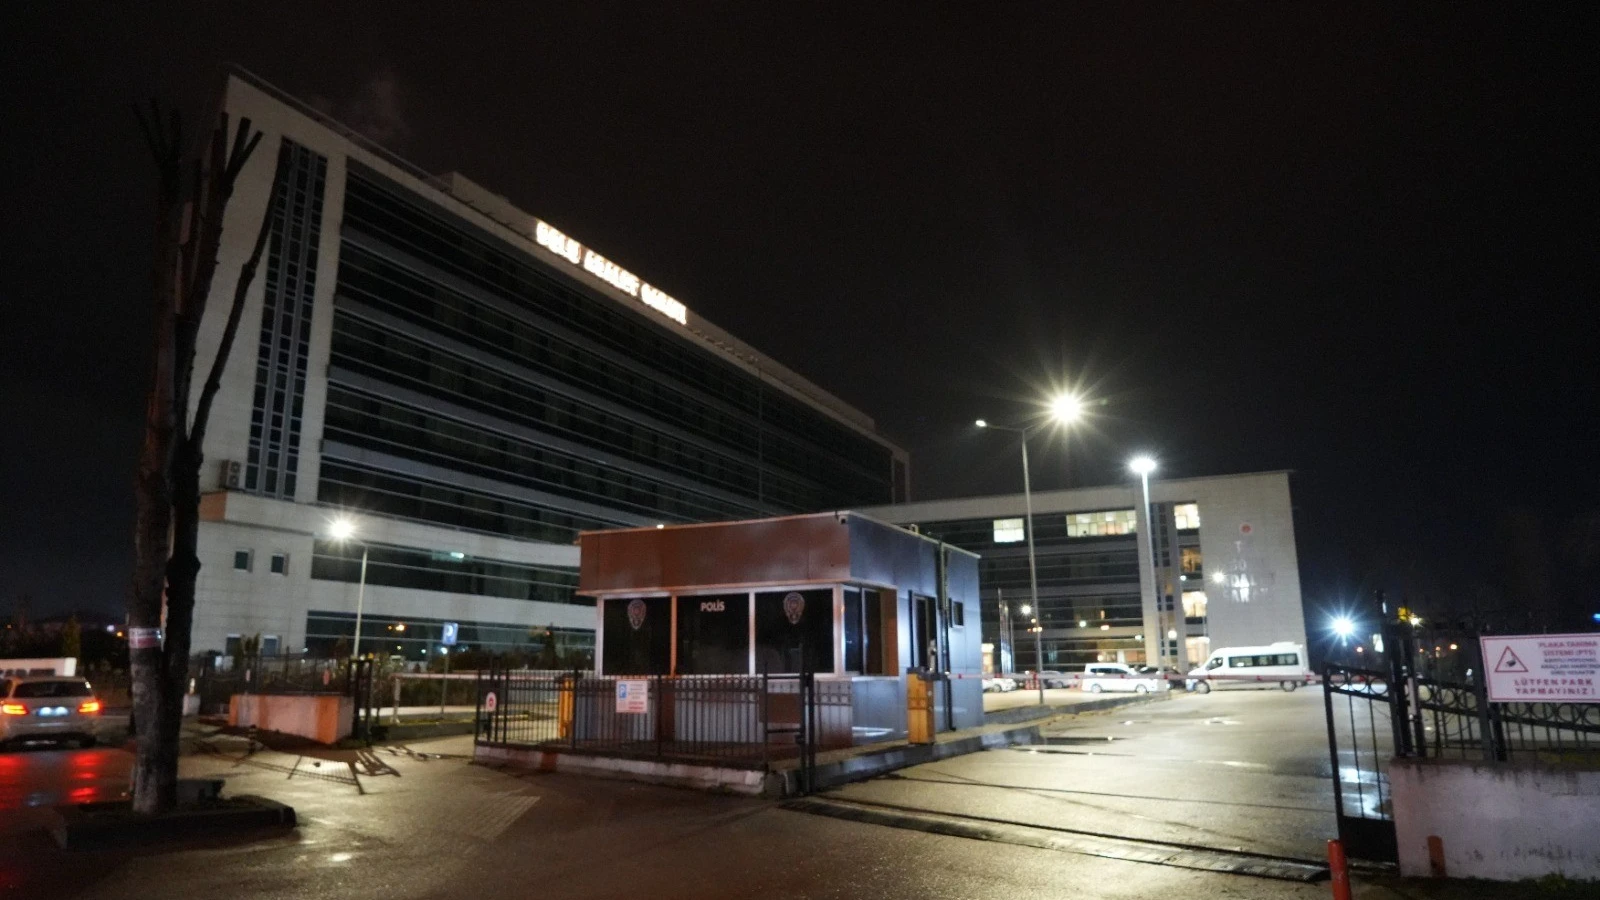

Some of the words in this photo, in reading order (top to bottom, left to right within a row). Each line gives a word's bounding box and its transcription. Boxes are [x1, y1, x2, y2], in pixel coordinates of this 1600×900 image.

[700, 599, 725, 612] POLİS
[1514, 678, 1558, 686] LÜTFEN
[1561, 678, 1593, 686] PARK
